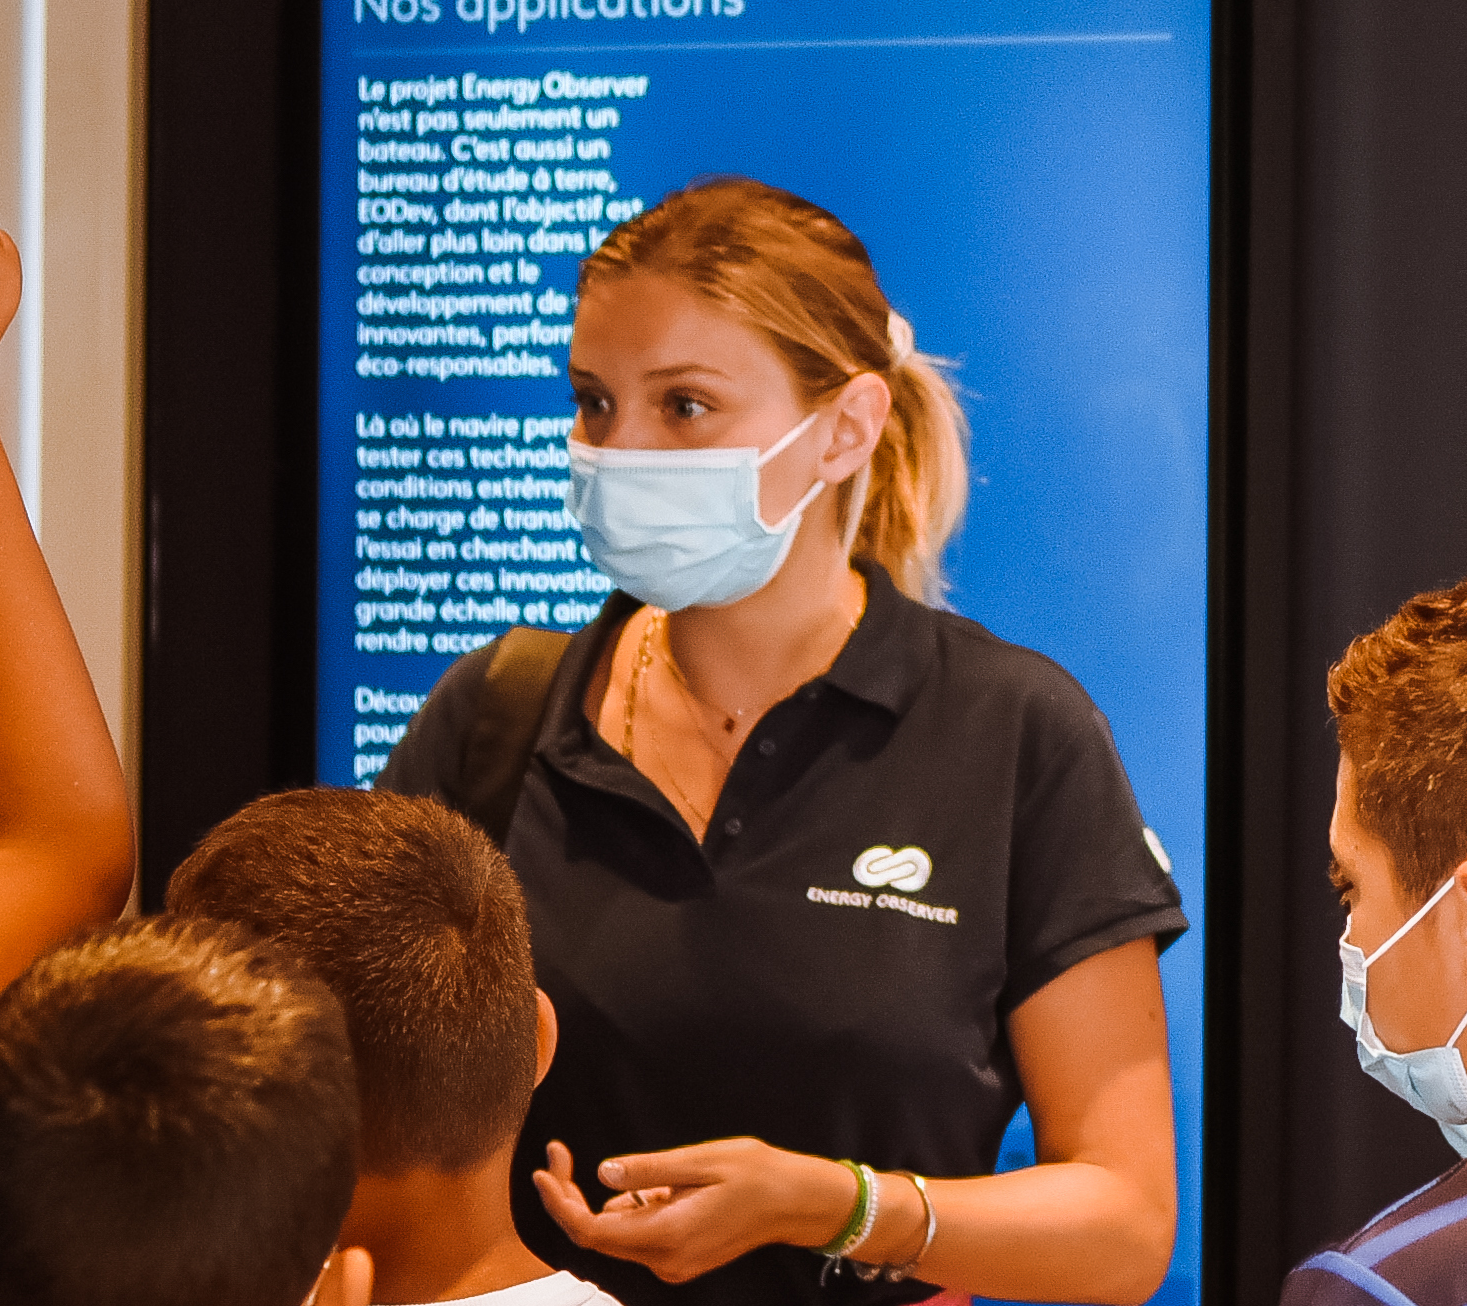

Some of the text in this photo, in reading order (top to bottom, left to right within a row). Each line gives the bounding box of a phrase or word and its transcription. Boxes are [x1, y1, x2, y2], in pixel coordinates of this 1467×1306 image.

[358, 70, 649, 106] Le projet Energy Observer
[358, 104, 620, 136] n'est pas seulement un
[358, 135, 611, 162] bateau. C'est aussi un
[358, 166, 618, 194] bureau d'étude à terre,
[358, 195, 644, 227] EODev, dont l'objectif est
[357, 228, 426, 254] d'aller
[430, 228, 478, 259] plus
[482, 228, 524, 253] loin
[528, 228, 584, 253] dans
[357, 258, 541, 290] conception et le
[357, 289, 532, 319] développement
[537, 287, 568, 315] de
[357, 323, 486, 348] innovantes,
[356, 352, 559, 382] éco-responsables.
[356, 413, 520, 439] Là où le navire
[356, 444, 571, 469] tester ces technolo
[356, 474, 474, 500] conditions
[356, 506, 499, 536] se charge de
[356, 536, 421, 561] l'essai
[427, 541, 456, 560] en
[461, 536, 577, 562] cherchant
[356, 567, 494, 595] déployer ces
[356, 600, 436, 627] grande
[440, 597, 520, 623] échelle
[524, 601, 549, 624] et
[356, 632, 428, 652] rendre
[806, 886, 959, 925] ENERGY OBSERVER
